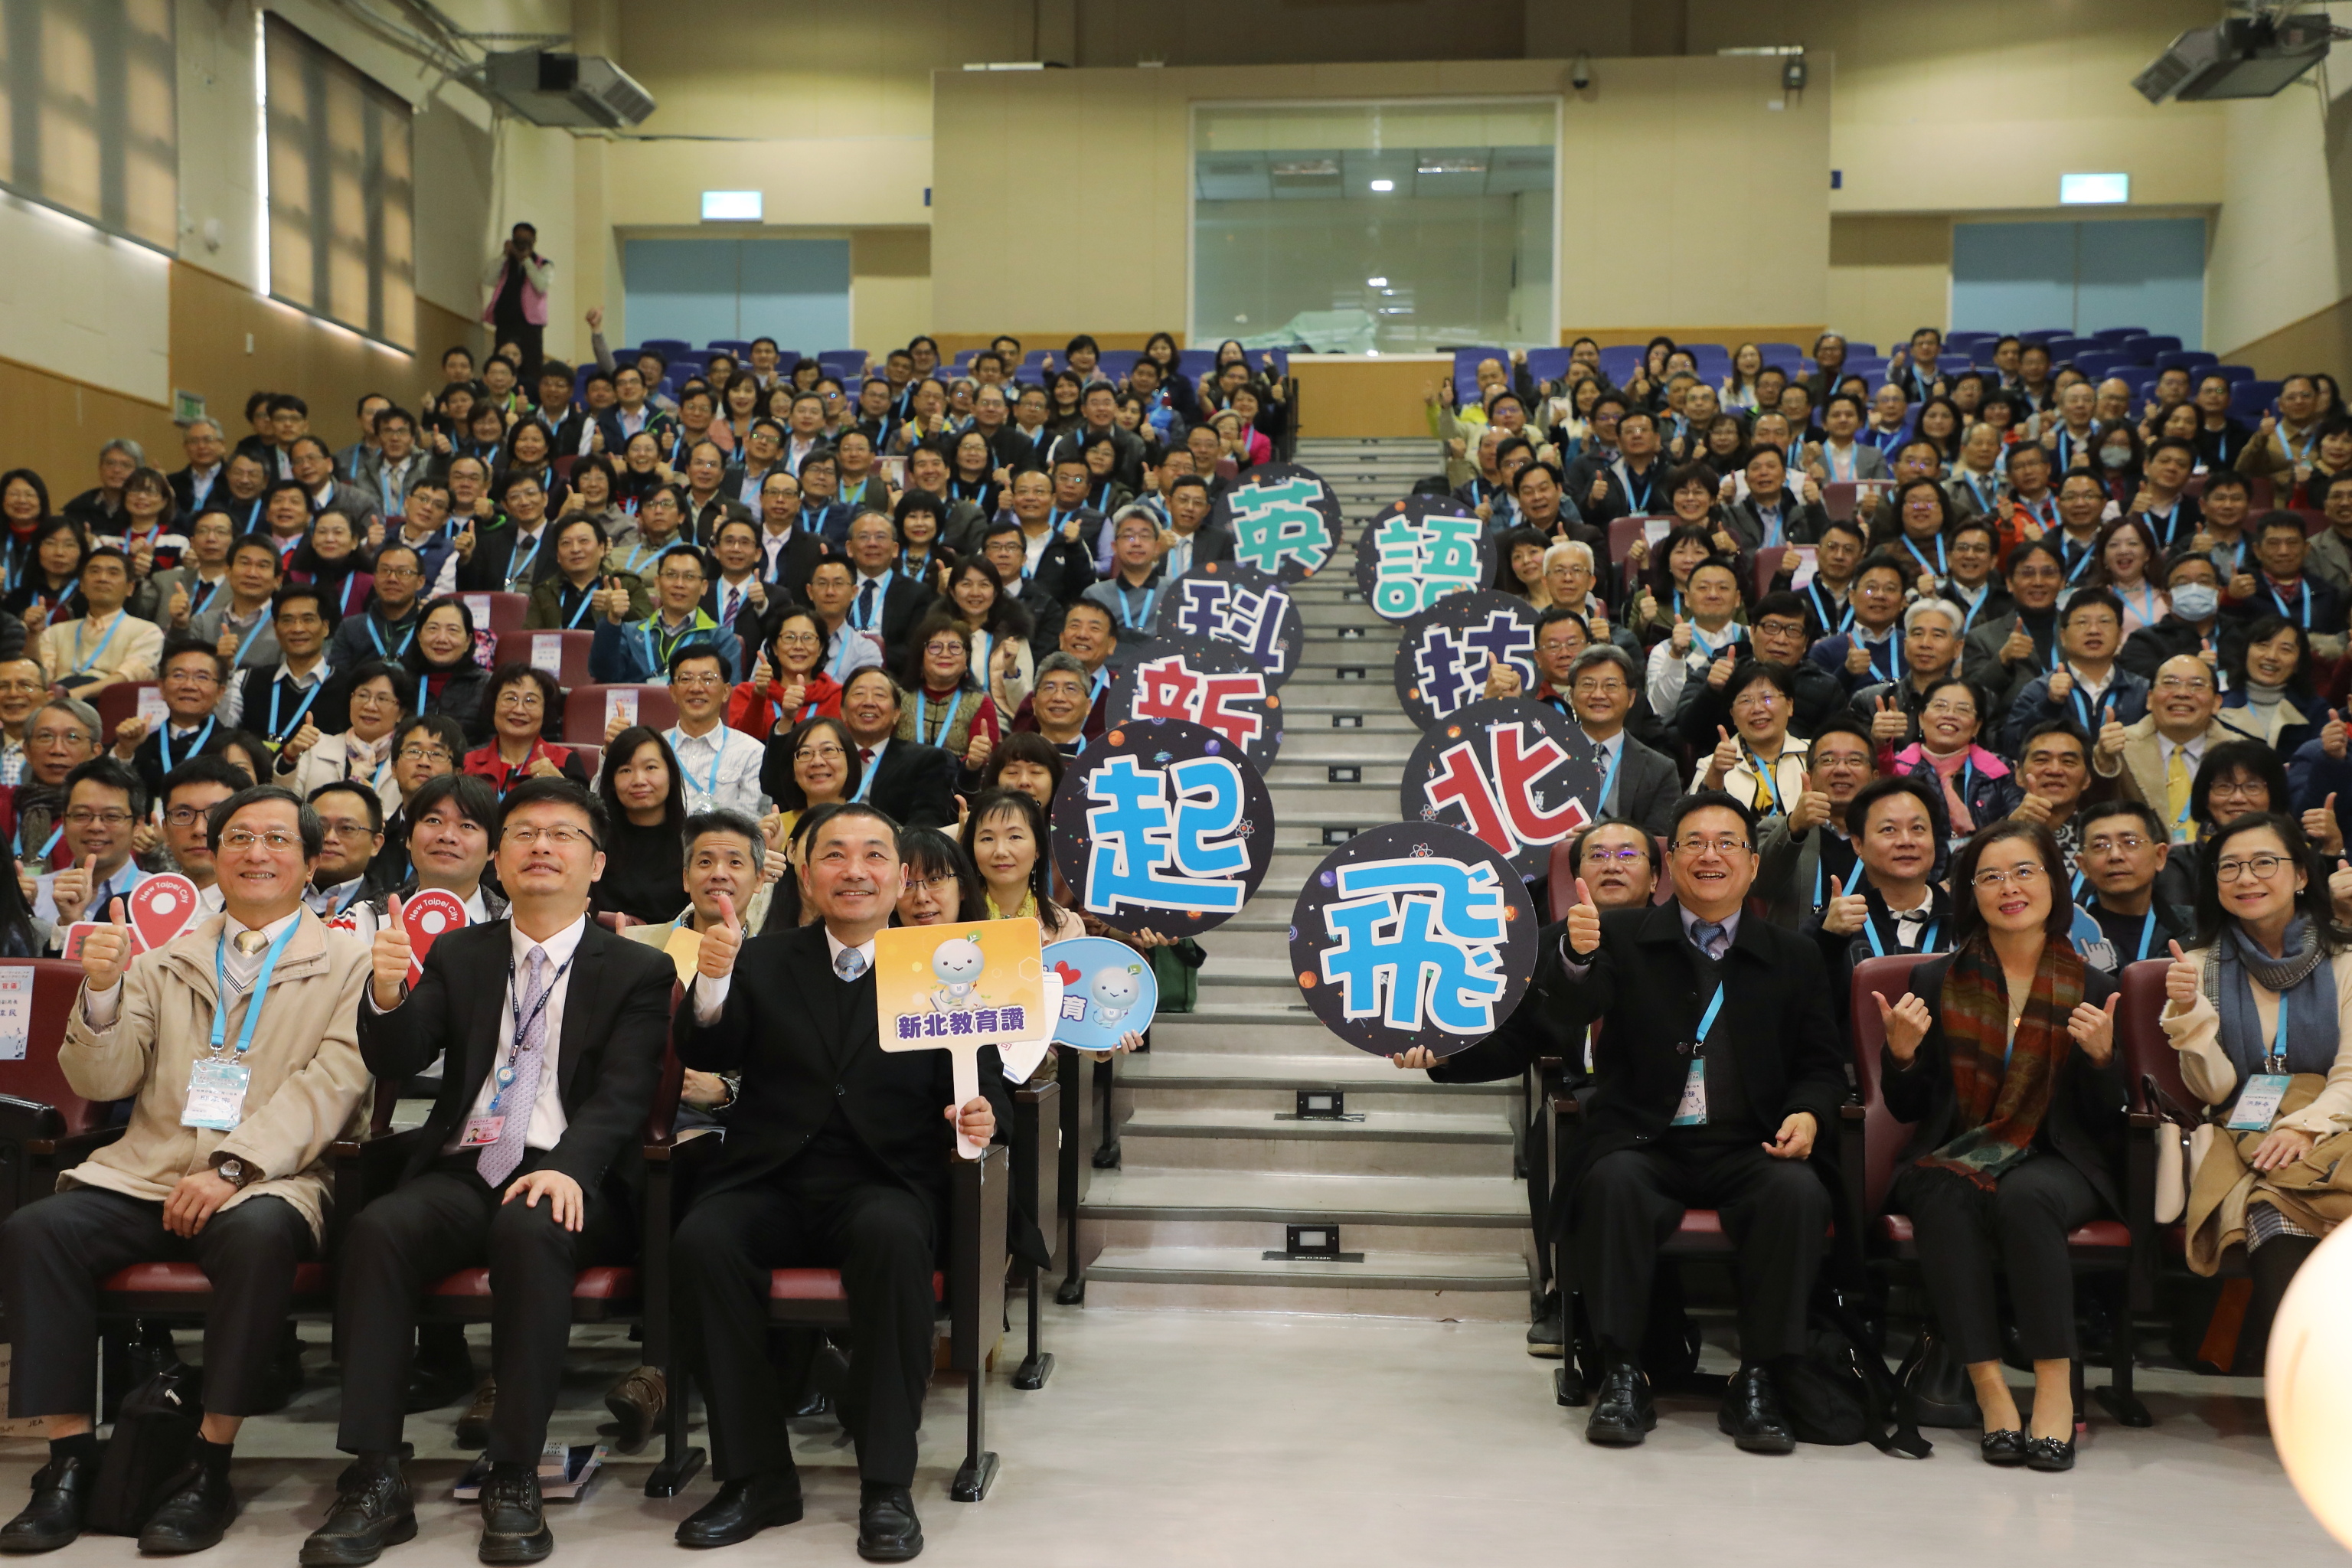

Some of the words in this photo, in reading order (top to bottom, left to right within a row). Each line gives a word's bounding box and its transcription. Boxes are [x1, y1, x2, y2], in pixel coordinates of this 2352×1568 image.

[1227, 476, 1333, 575] 英
[1373, 514, 1484, 619] 語
[1178, 579, 1290, 675] 科
[1415, 610, 1536, 720] 技
[1131, 655, 1266, 756] 新
[1084, 753, 1252, 915] 起
[1423, 721, 1592, 860] 北
[139, 886, 155, 902] New
[155, 880, 182, 891] Taipei
[179, 887, 190, 904] City
[408, 903, 423, 921] New
[423, 897, 450, 908] Taipei
[448, 906, 459, 922] City
[1320, 858, 1508, 1035] 飛
[897, 1006, 1025, 1040] 新北教育讚
